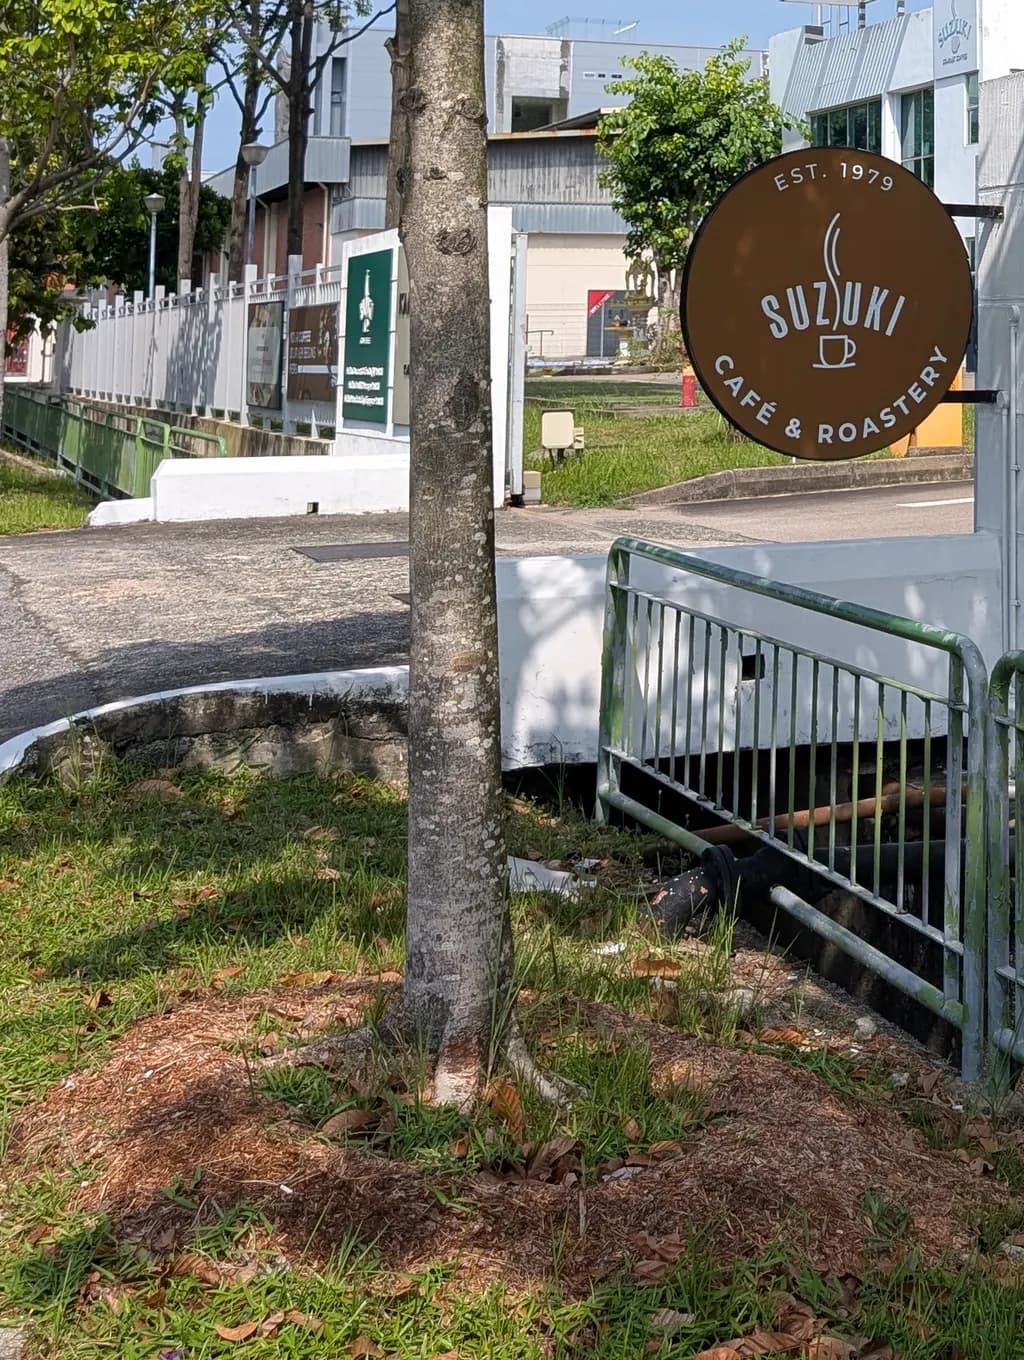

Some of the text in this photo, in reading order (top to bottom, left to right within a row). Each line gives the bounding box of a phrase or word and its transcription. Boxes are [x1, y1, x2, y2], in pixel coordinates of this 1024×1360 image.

[773, 161, 894, 192] EST. 1979
[760, 281, 907, 340] SUZUKI
[714, 345, 950, 444] CAFÉ & ROASTERY
